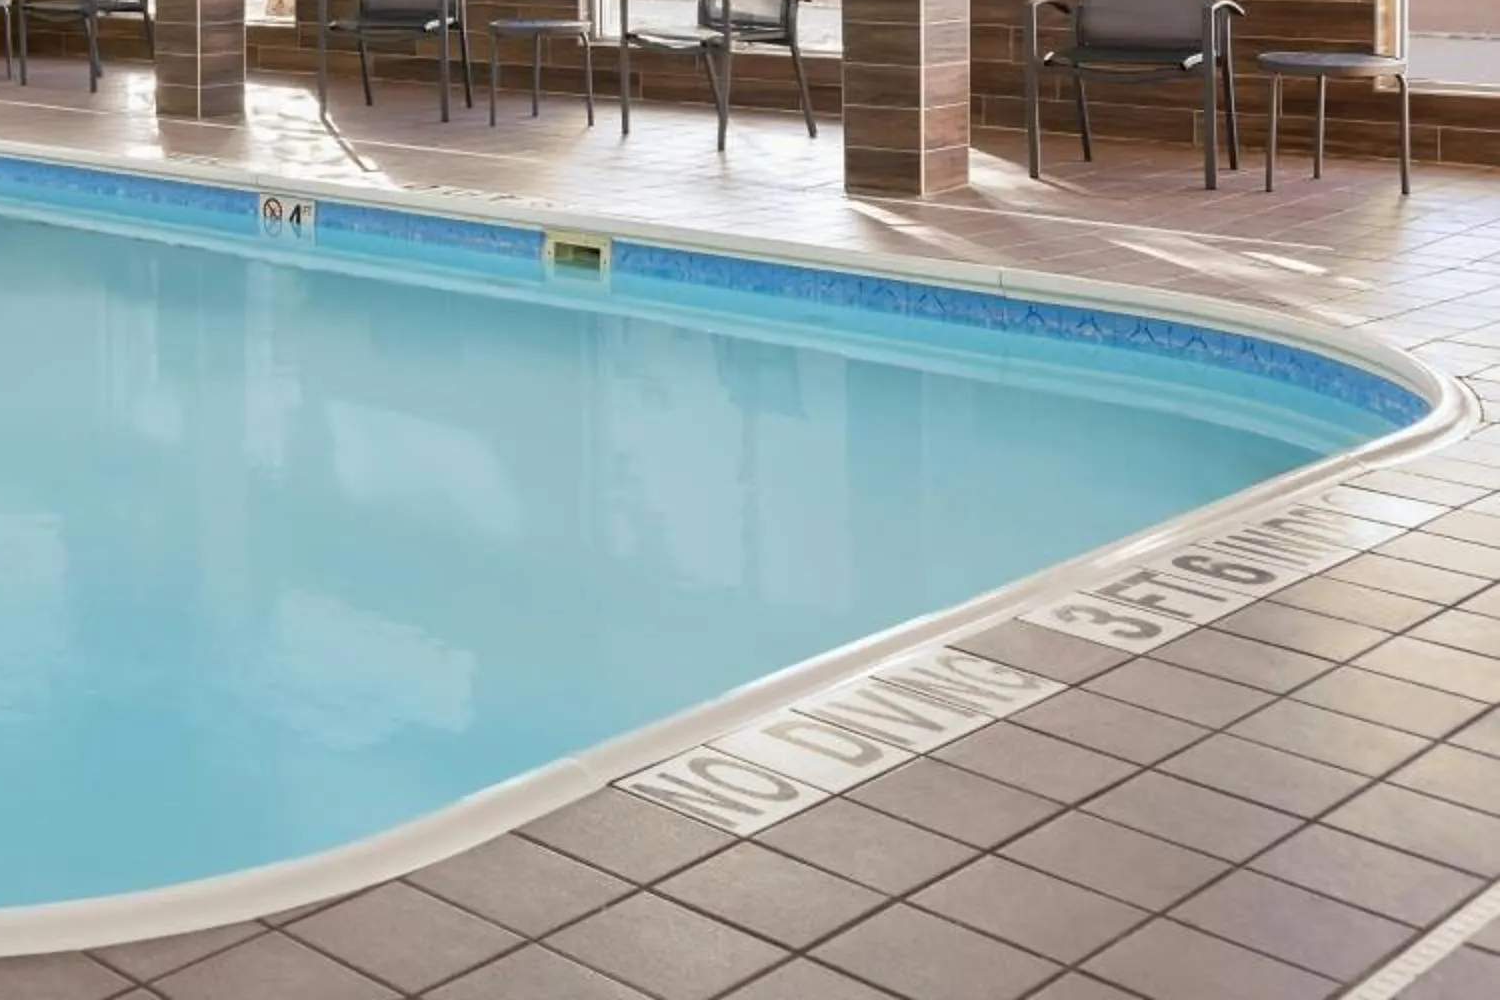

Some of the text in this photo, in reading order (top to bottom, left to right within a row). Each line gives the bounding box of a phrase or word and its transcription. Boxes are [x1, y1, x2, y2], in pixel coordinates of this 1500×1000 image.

[1171, 554, 1279, 585] 6
[1096, 569, 1229, 619] FT
[1052, 604, 1164, 640] 3
[632, 653, 1043, 829] NO DIVING
